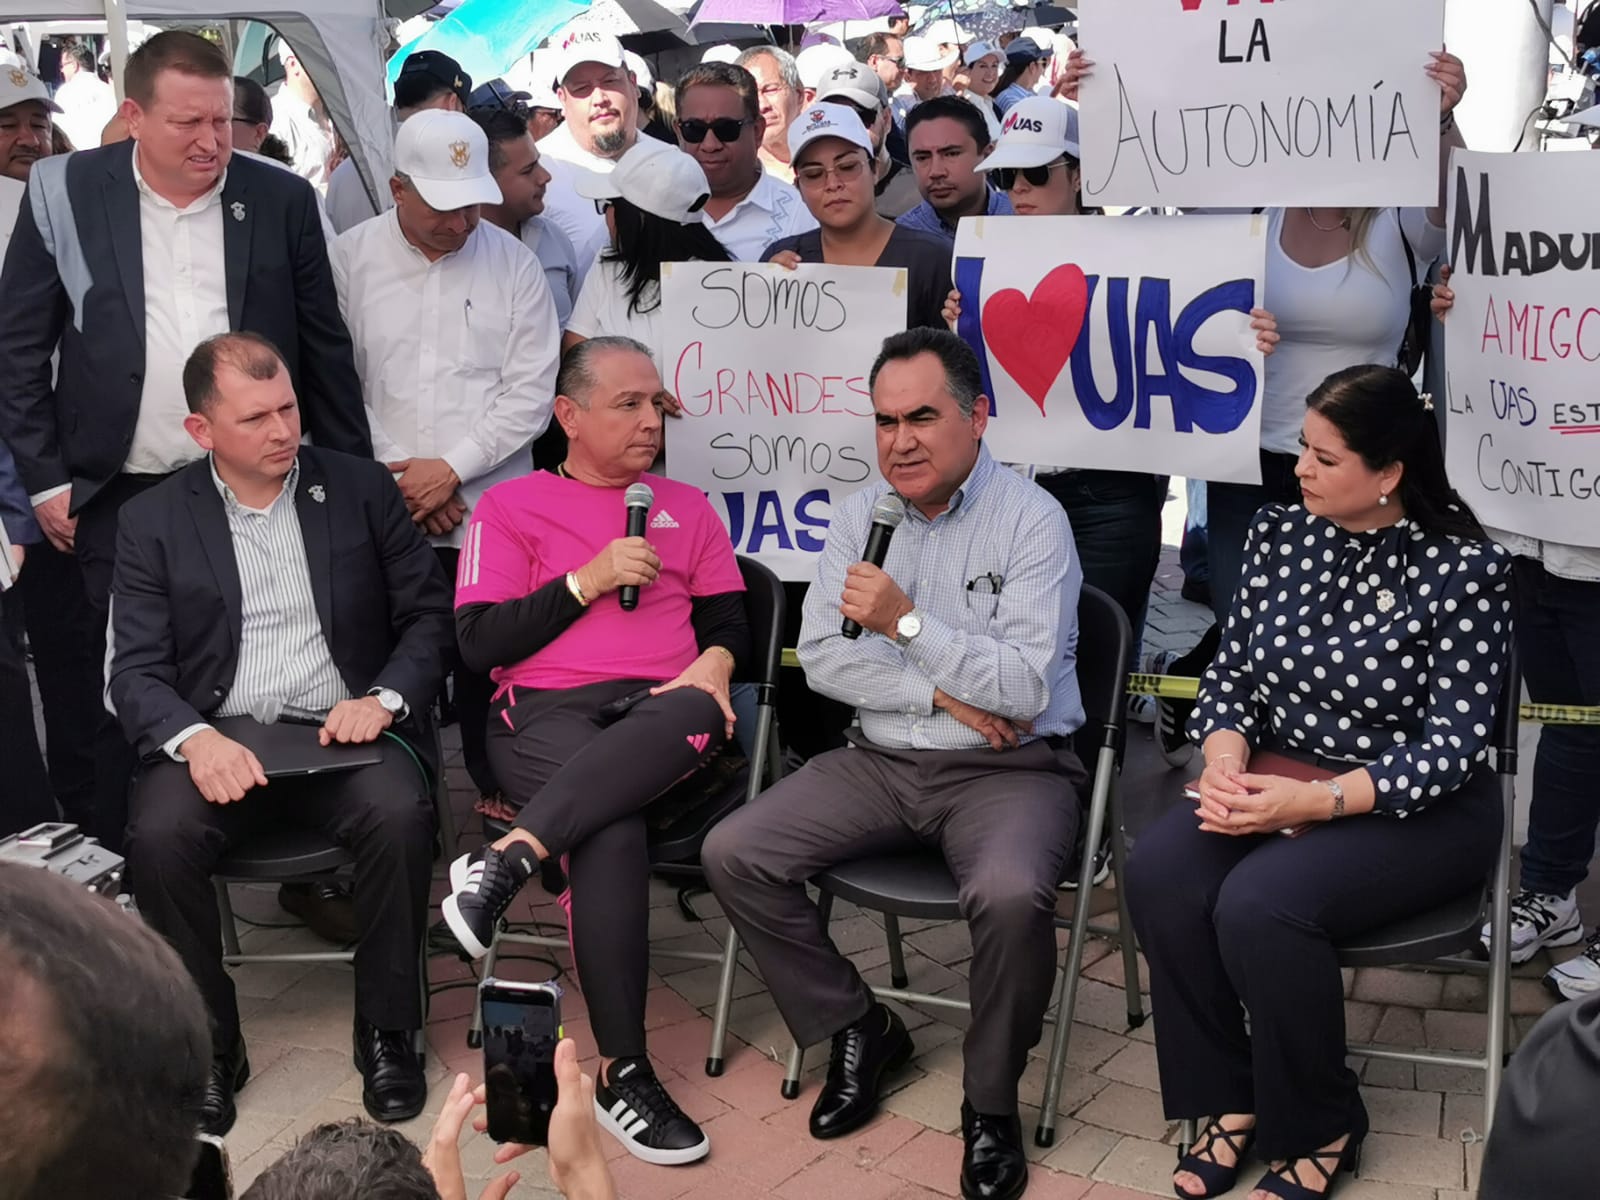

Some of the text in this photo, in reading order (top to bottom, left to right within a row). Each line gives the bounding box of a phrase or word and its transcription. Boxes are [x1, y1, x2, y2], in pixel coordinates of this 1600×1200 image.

[1219, 18, 1270, 63] LA
[1086, 63, 1419, 195] AUTONOMÍA
[692, 268, 847, 332] SOMOS
[674, 341, 876, 417] GRANDES
[1070, 273, 1257, 434] UAS
[1489, 379, 1537, 426] UAS
[710, 432, 871, 483] SOMOS
